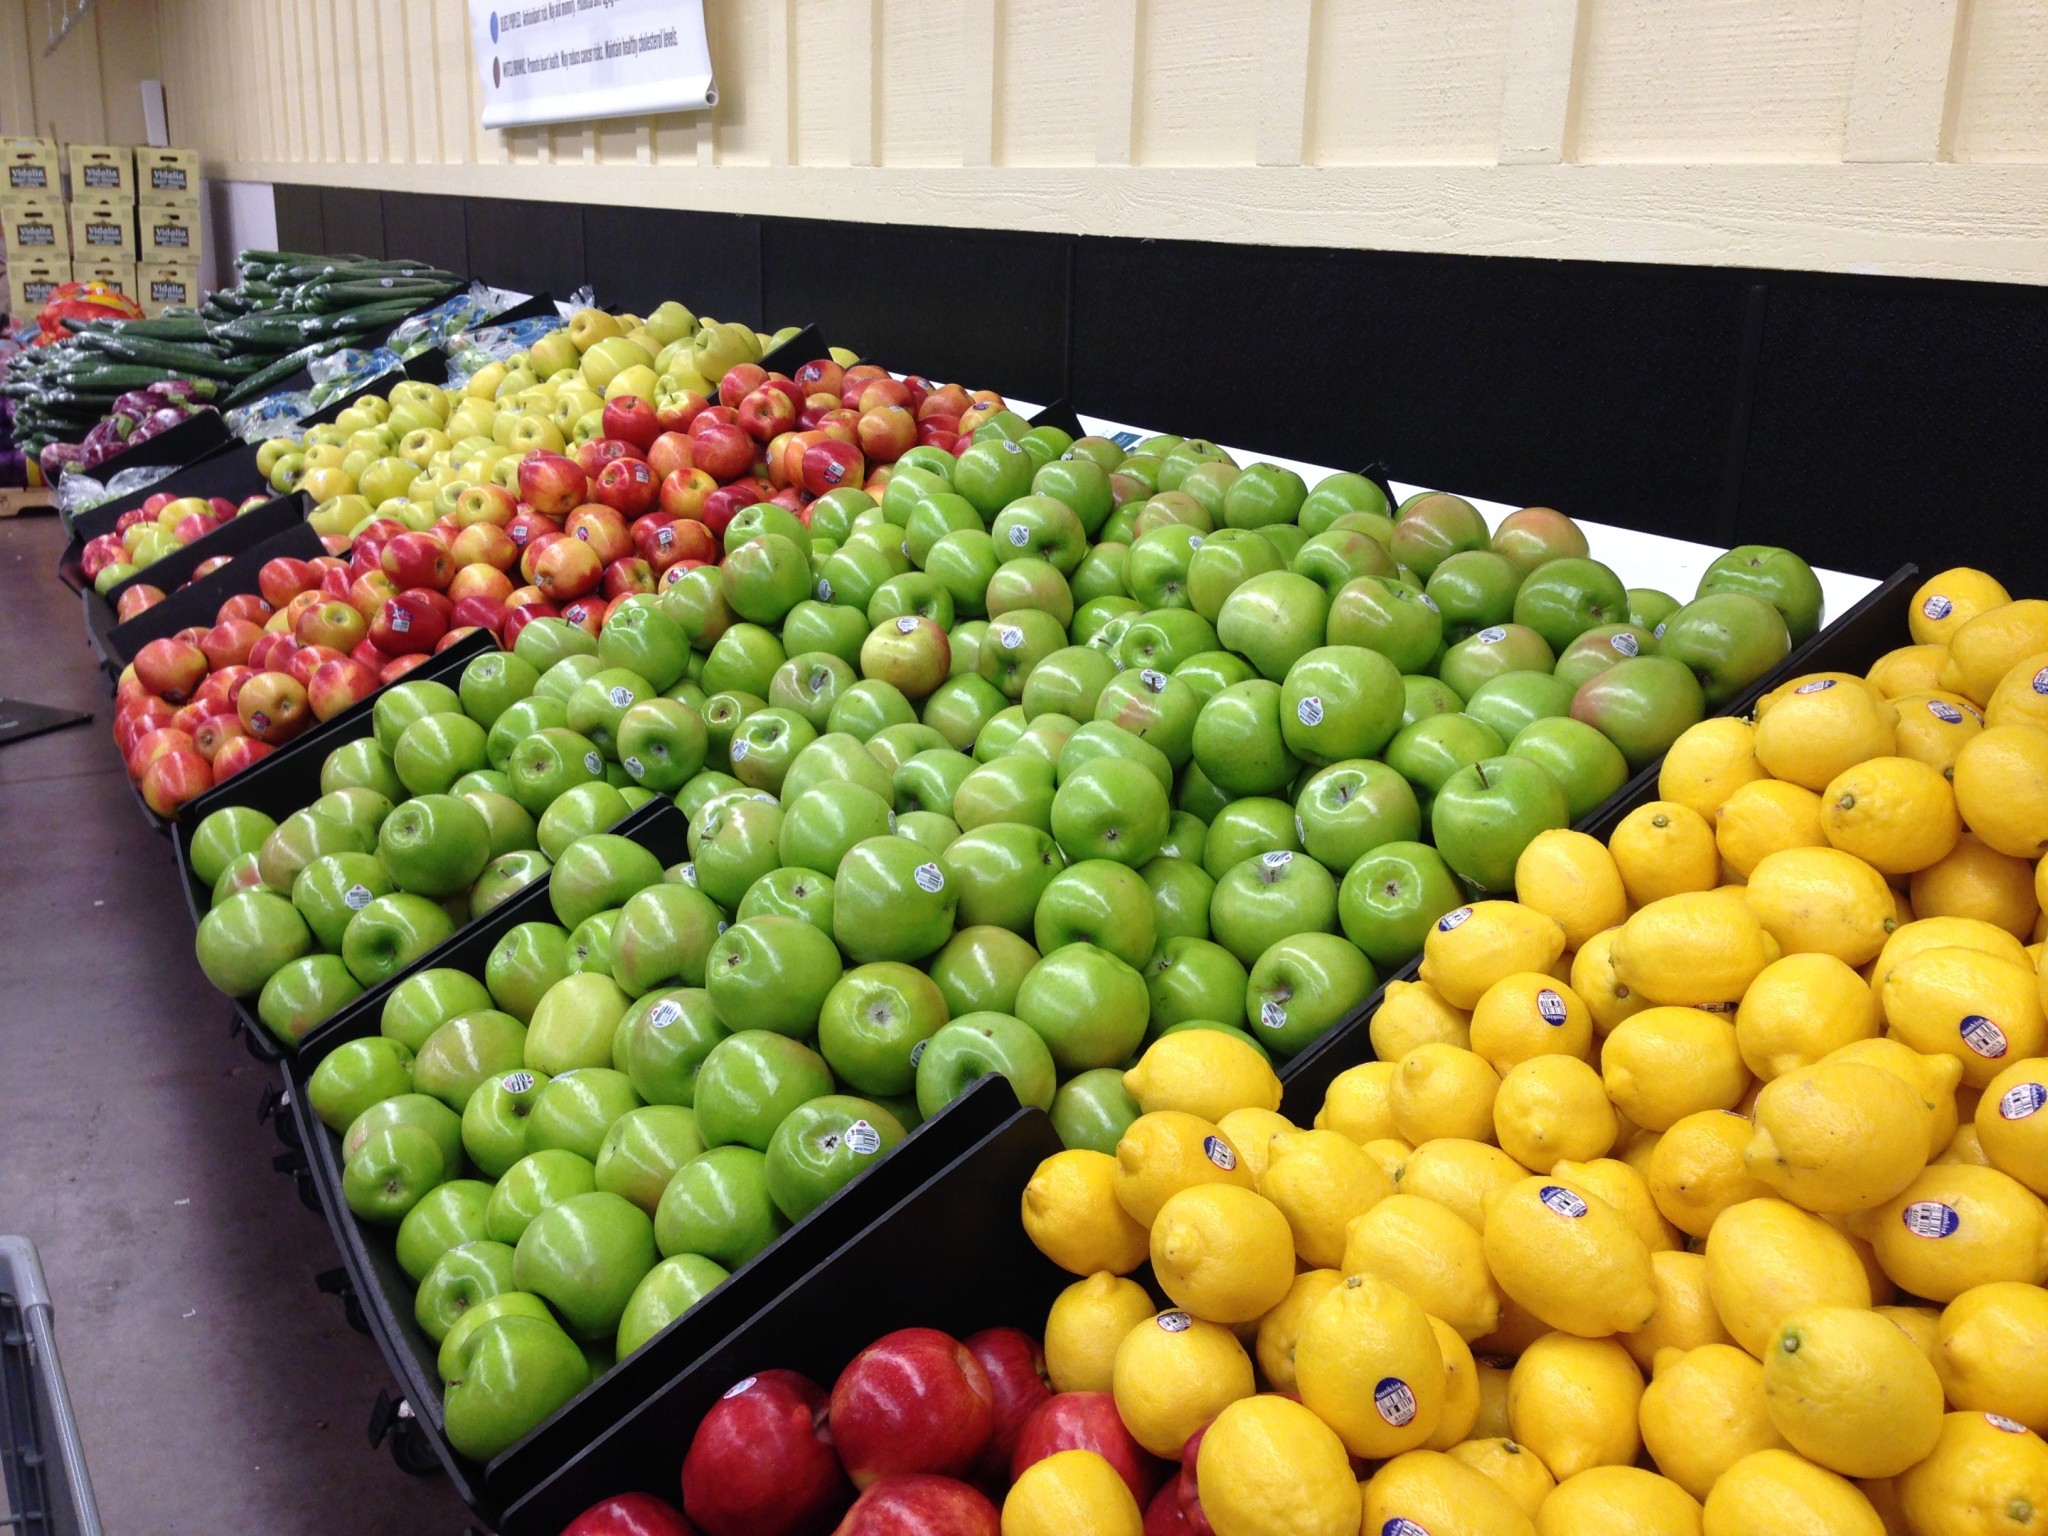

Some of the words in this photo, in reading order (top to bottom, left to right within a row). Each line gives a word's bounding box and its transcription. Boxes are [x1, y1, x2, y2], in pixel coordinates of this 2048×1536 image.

[12, 168, 44, 178] Vidalia
[86, 168, 117, 177] Vidalia
[153, 170, 184, 180] Vidalia
[20, 227, 52, 236] Vidalia
[88, 226, 119, 236] Vidalia
[156, 228, 186, 237] Vidalia
[153, 284, 184, 293] Vidalia
[1912, 1208, 1920, 1227] 4053
[1943, 1206, 1953, 1234] Sunkist
[1376, 1382, 1402, 1399] Sunkist
[1394, 1408, 1412, 1421] 4053
